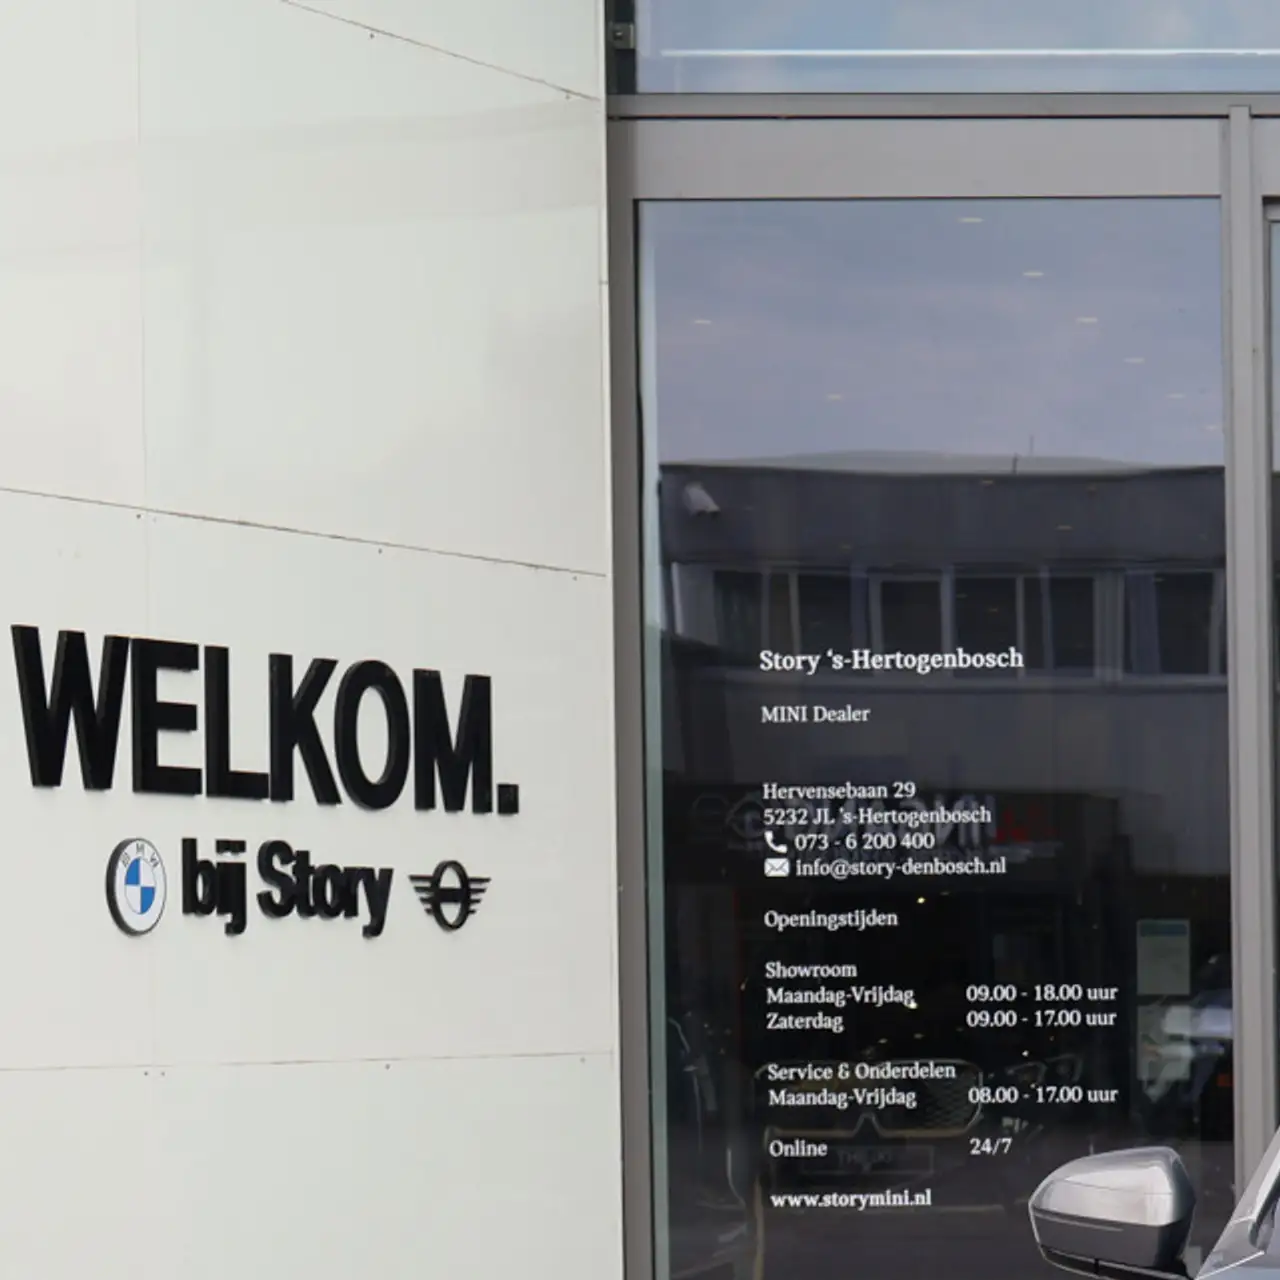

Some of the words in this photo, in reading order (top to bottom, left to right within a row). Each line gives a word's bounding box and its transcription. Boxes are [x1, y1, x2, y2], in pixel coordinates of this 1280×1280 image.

[759, 649, 822, 676] Story
[11, 625, 520, 814] WELKOM.
[761, 705, 808, 723] MINI
[812, 704, 871, 723] Dealer
[762, 781, 889, 802] Hervensebaan
[892, 781, 917, 799] 29
[763, 807, 809, 826] 5232
[811, 807, 835, 826] JL
[794, 832, 830, 852] 073
[844, 831, 858, 851] 6
[861, 831, 897, 850] 200
[899, 831, 936, 850] 400
[795, 856, 1007, 881] info@story-denbosch.nl
[256, 840, 393, 937] Story
[763, 908, 899, 931] Openingstijden
[765, 960, 858, 979] Showroom
[766, 985, 917, 1009] Maandag-Vrijdag
[965, 984, 1018, 1002] 09.00
[1034, 983, 1084, 1002] 18.00
[1086, 987, 1119, 1001] uur
[766, 1011, 845, 1034] Zaterdag
[965, 1009, 1018, 1028] 09.00
[1034, 1009, 1082, 1027] 17.00
[1085, 1012, 1118, 1026] uur
[766, 1062, 834, 1082] Service
[837, 1061, 851, 1080] &
[854, 1060, 957, 1080] Onderdelen
[768, 1086, 918, 1110] Maandag-Vrijdag
[967, 1086, 1020, 1104] 08.00
[1035, 1085, 1084, 1104] 17.00
[1086, 1089, 1119, 1103] uur
[768, 1139, 828, 1158] Online
[969, 1137, 1013, 1155] 24/7
[769, 1187, 932, 1212] www.storymini.nl
